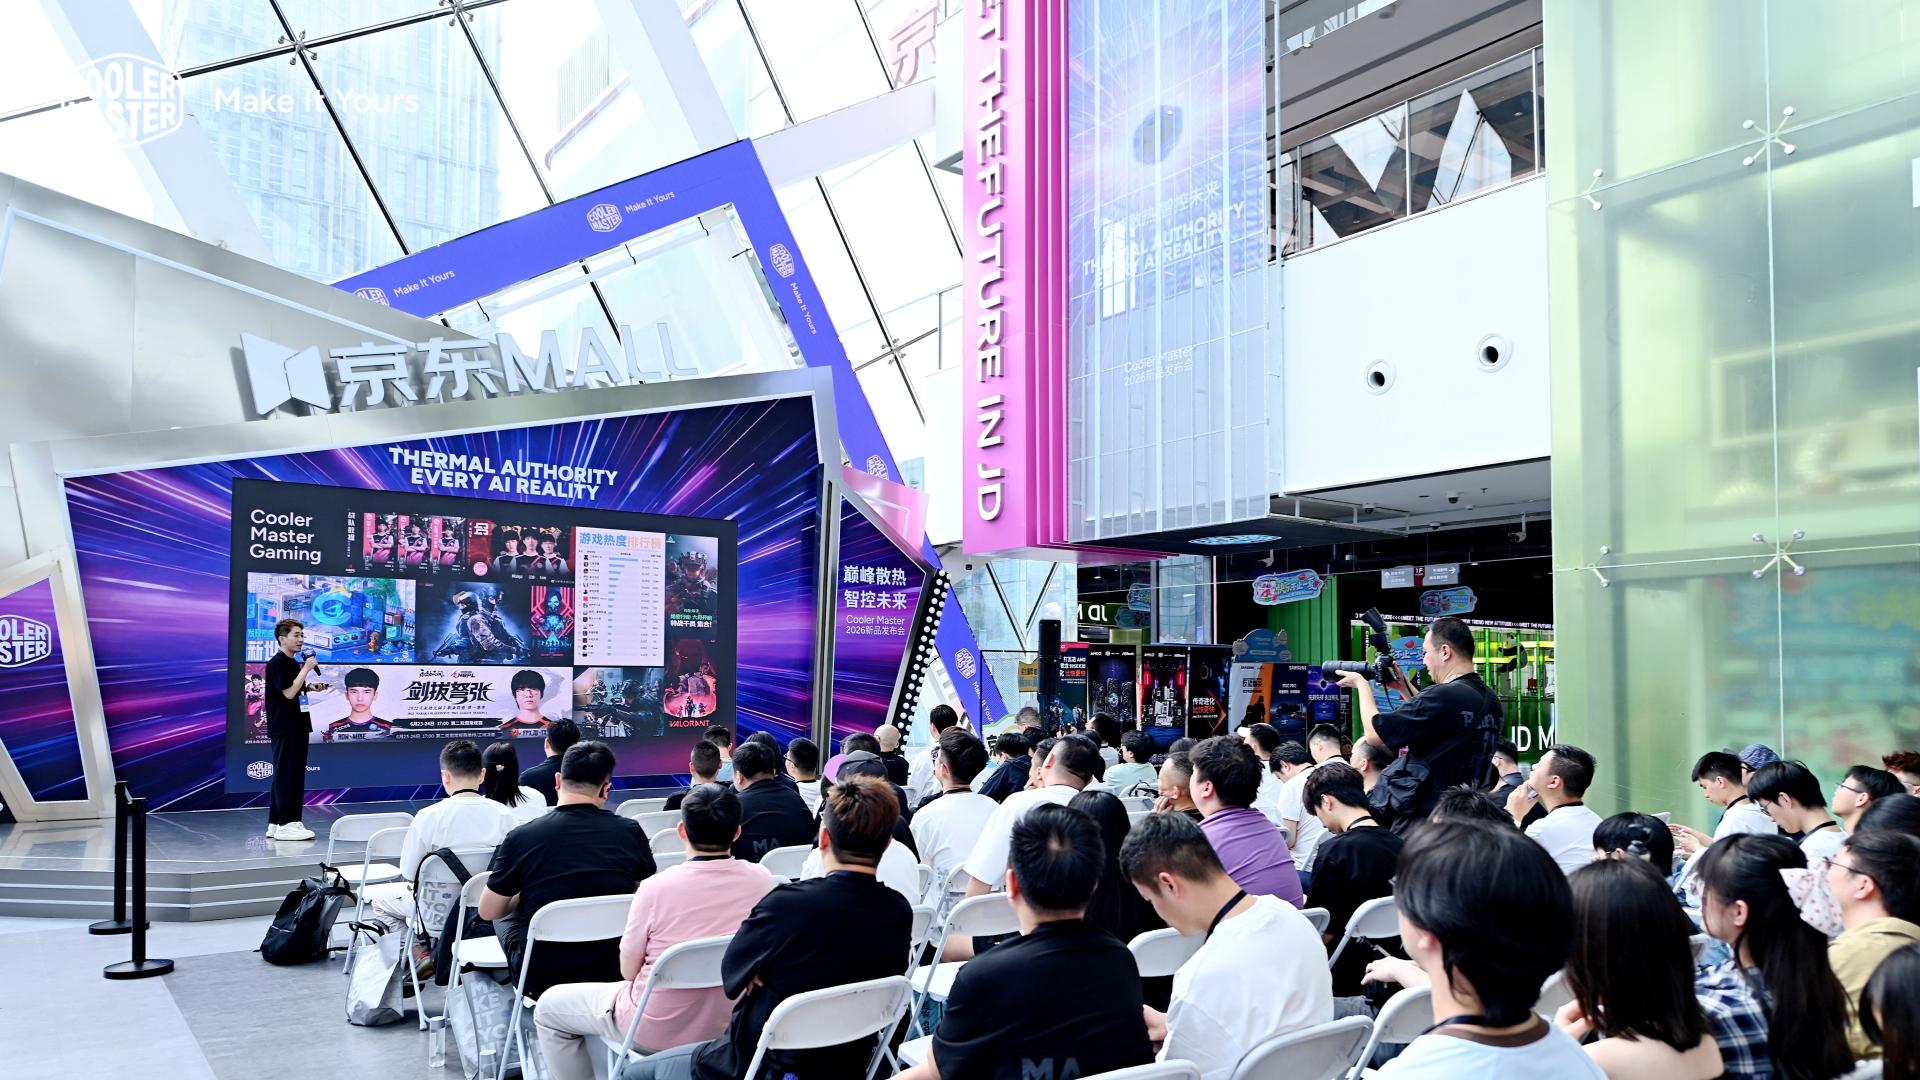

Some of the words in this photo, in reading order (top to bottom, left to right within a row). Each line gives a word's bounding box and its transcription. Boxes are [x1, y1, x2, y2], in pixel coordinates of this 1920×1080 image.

[977, 47, 1004, 165] THE
[625, 202, 647, 214] Make
[646, 198, 654, 207] It
[653, 191, 675, 204] Yours
[589, 205, 618, 223] COOLER
[591, 213, 621, 231] MASTER
[393, 283, 420, 297] Make
[419, 279, 429, 288] It
[428, 270, 456, 284] Yours
[977, 162, 1004, 383] FUTURE
[790, 282, 803, 304] Make
[804, 311, 817, 335] Yours
[329, 322, 699, 408] 京东MALL
[977, 394, 1004, 449] IN
[388, 447, 496, 474] THERMAL
[501, 459, 618, 486] AUTHORITY
[411, 467, 484, 490] EVERY
[488, 475, 511, 493] AI
[516, 477, 600, 501] REALITY
[977, 463, 1004, 522] JD
[250, 509, 314, 527] Cooler
[250, 527, 315, 544] Master
[249, 544, 322, 565] Gaming
[843, 565, 907, 586] 巅峰散热
[843, 590, 907, 610] 智控未来
[0, 619, 47, 641] OLER
[846, 615, 875, 624] Cooler
[877, 616, 905, 625] Master
[846, 626, 905, 636] 2026新品发布会
[0, 641, 47, 663] STER
[247, 640, 279, 662] 新世
[401, 681, 496, 705] 剑拔弩张
[669, 720, 710, 728] VALORANT
[249, 762, 272, 771] COOLER
[249, 769, 272, 778] MASTER
